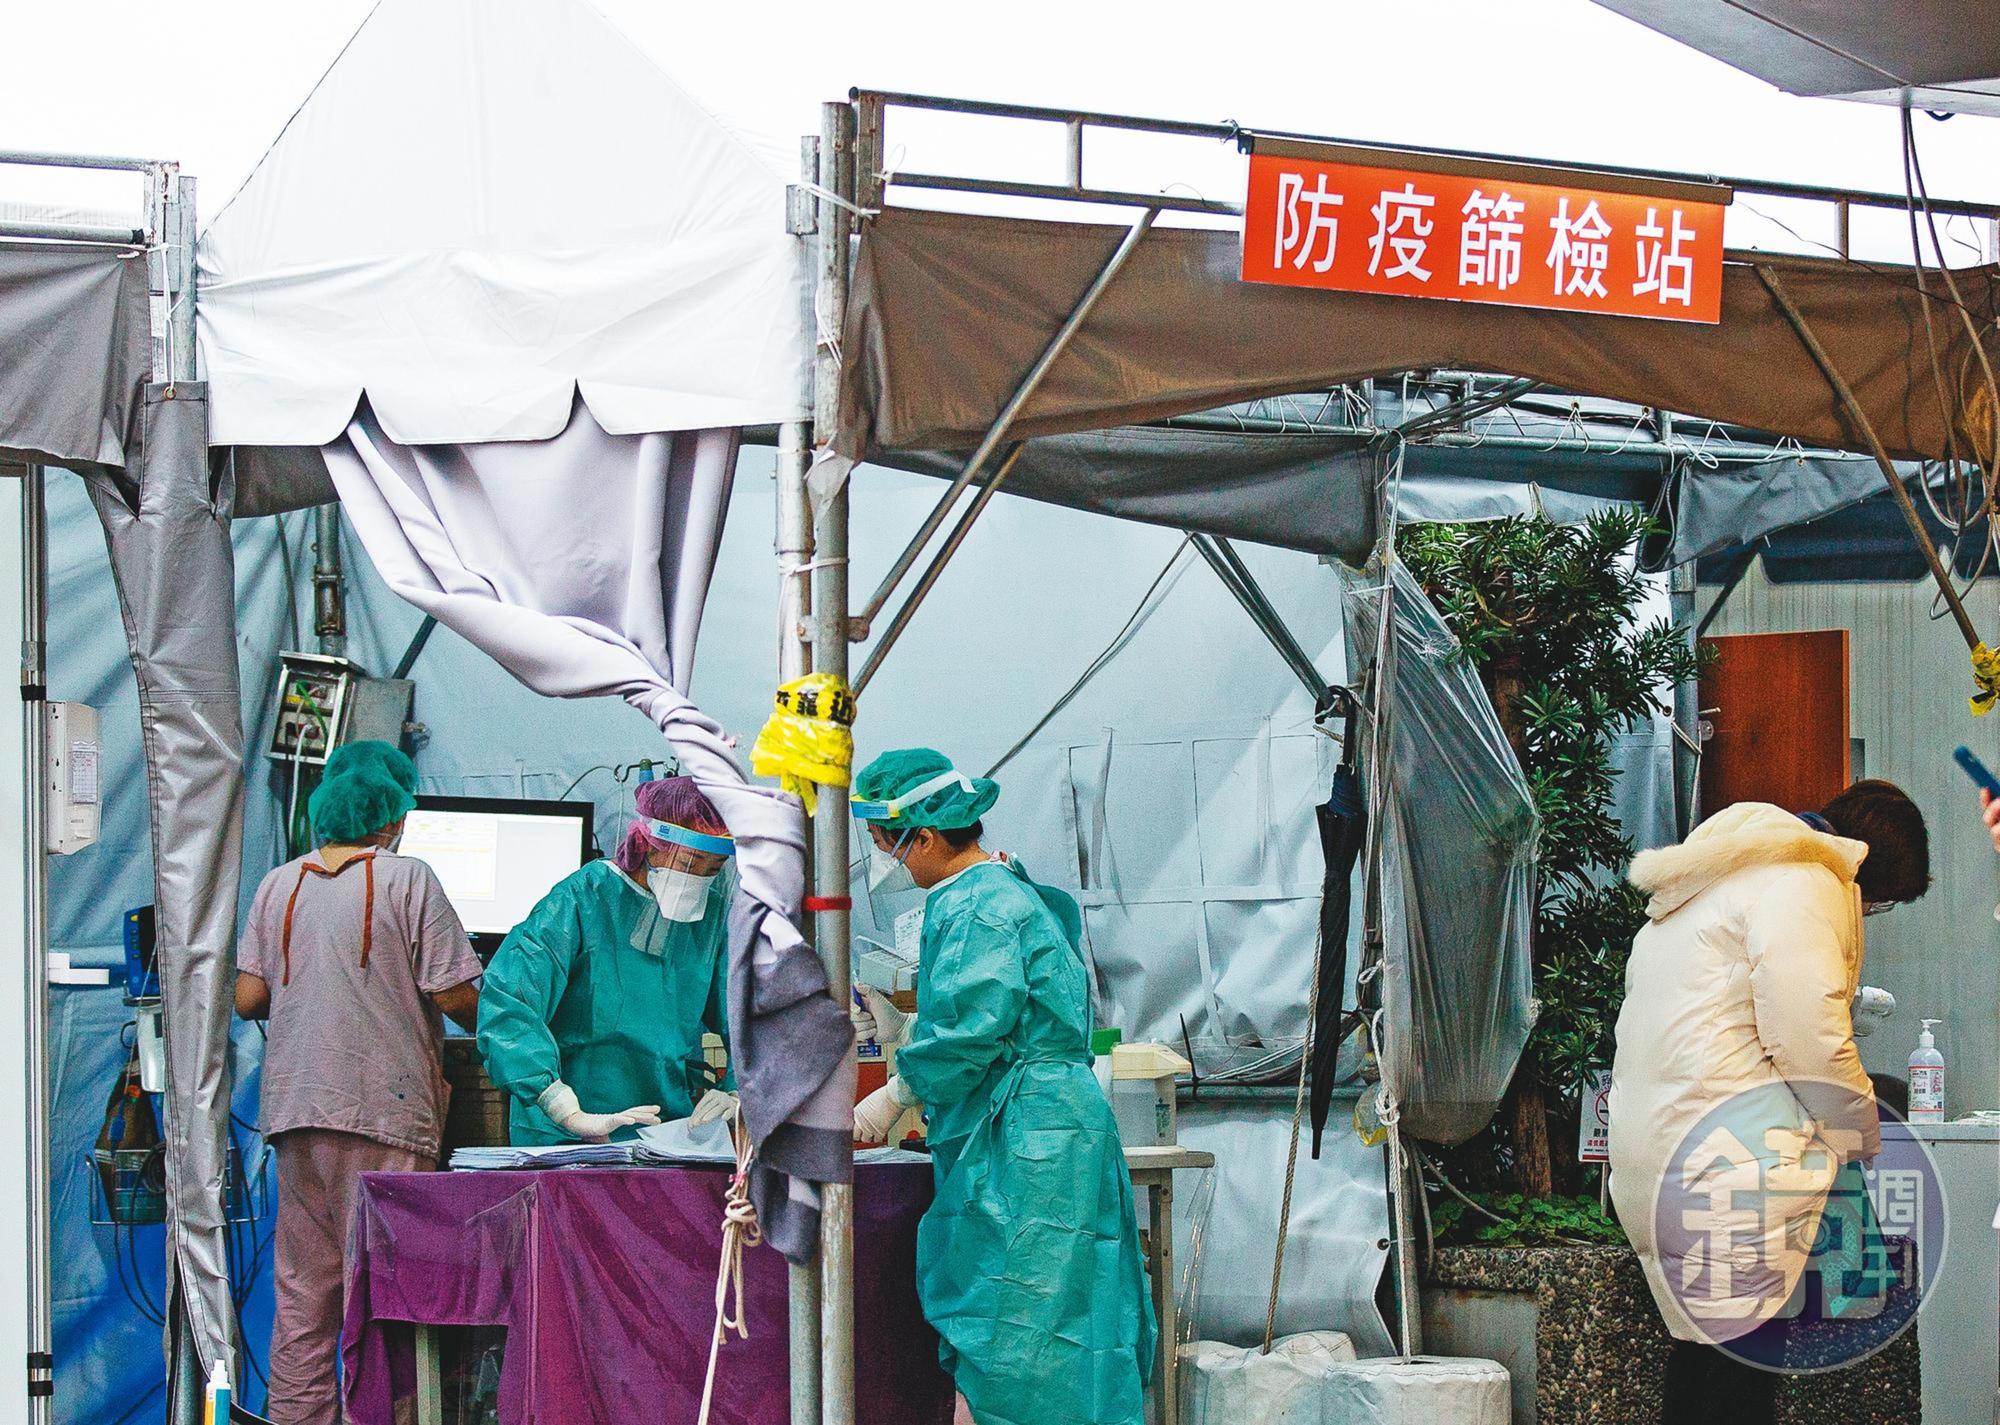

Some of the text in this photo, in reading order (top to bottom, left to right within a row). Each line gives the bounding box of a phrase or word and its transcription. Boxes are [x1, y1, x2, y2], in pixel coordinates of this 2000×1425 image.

[1273, 172, 1696, 307] 防疫篩檢站
